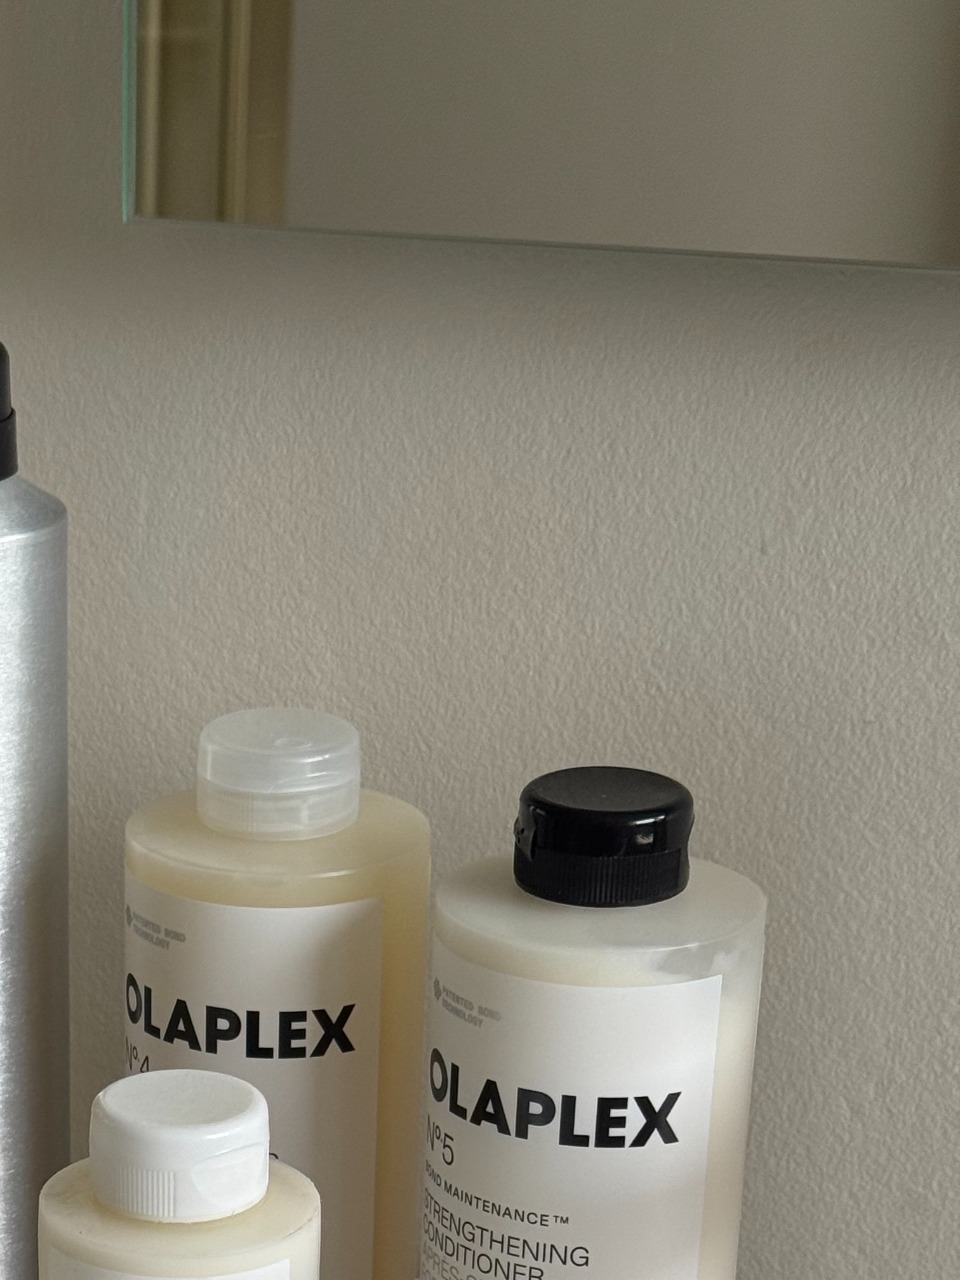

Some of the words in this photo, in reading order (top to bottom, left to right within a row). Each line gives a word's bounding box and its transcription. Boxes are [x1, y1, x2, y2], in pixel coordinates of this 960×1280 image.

[126, 972, 356, 1059] OLAPLEX
[430, 1047, 682, 1149] OLAPLEX
[423, 1187, 590, 1267] STRENGTHENING
